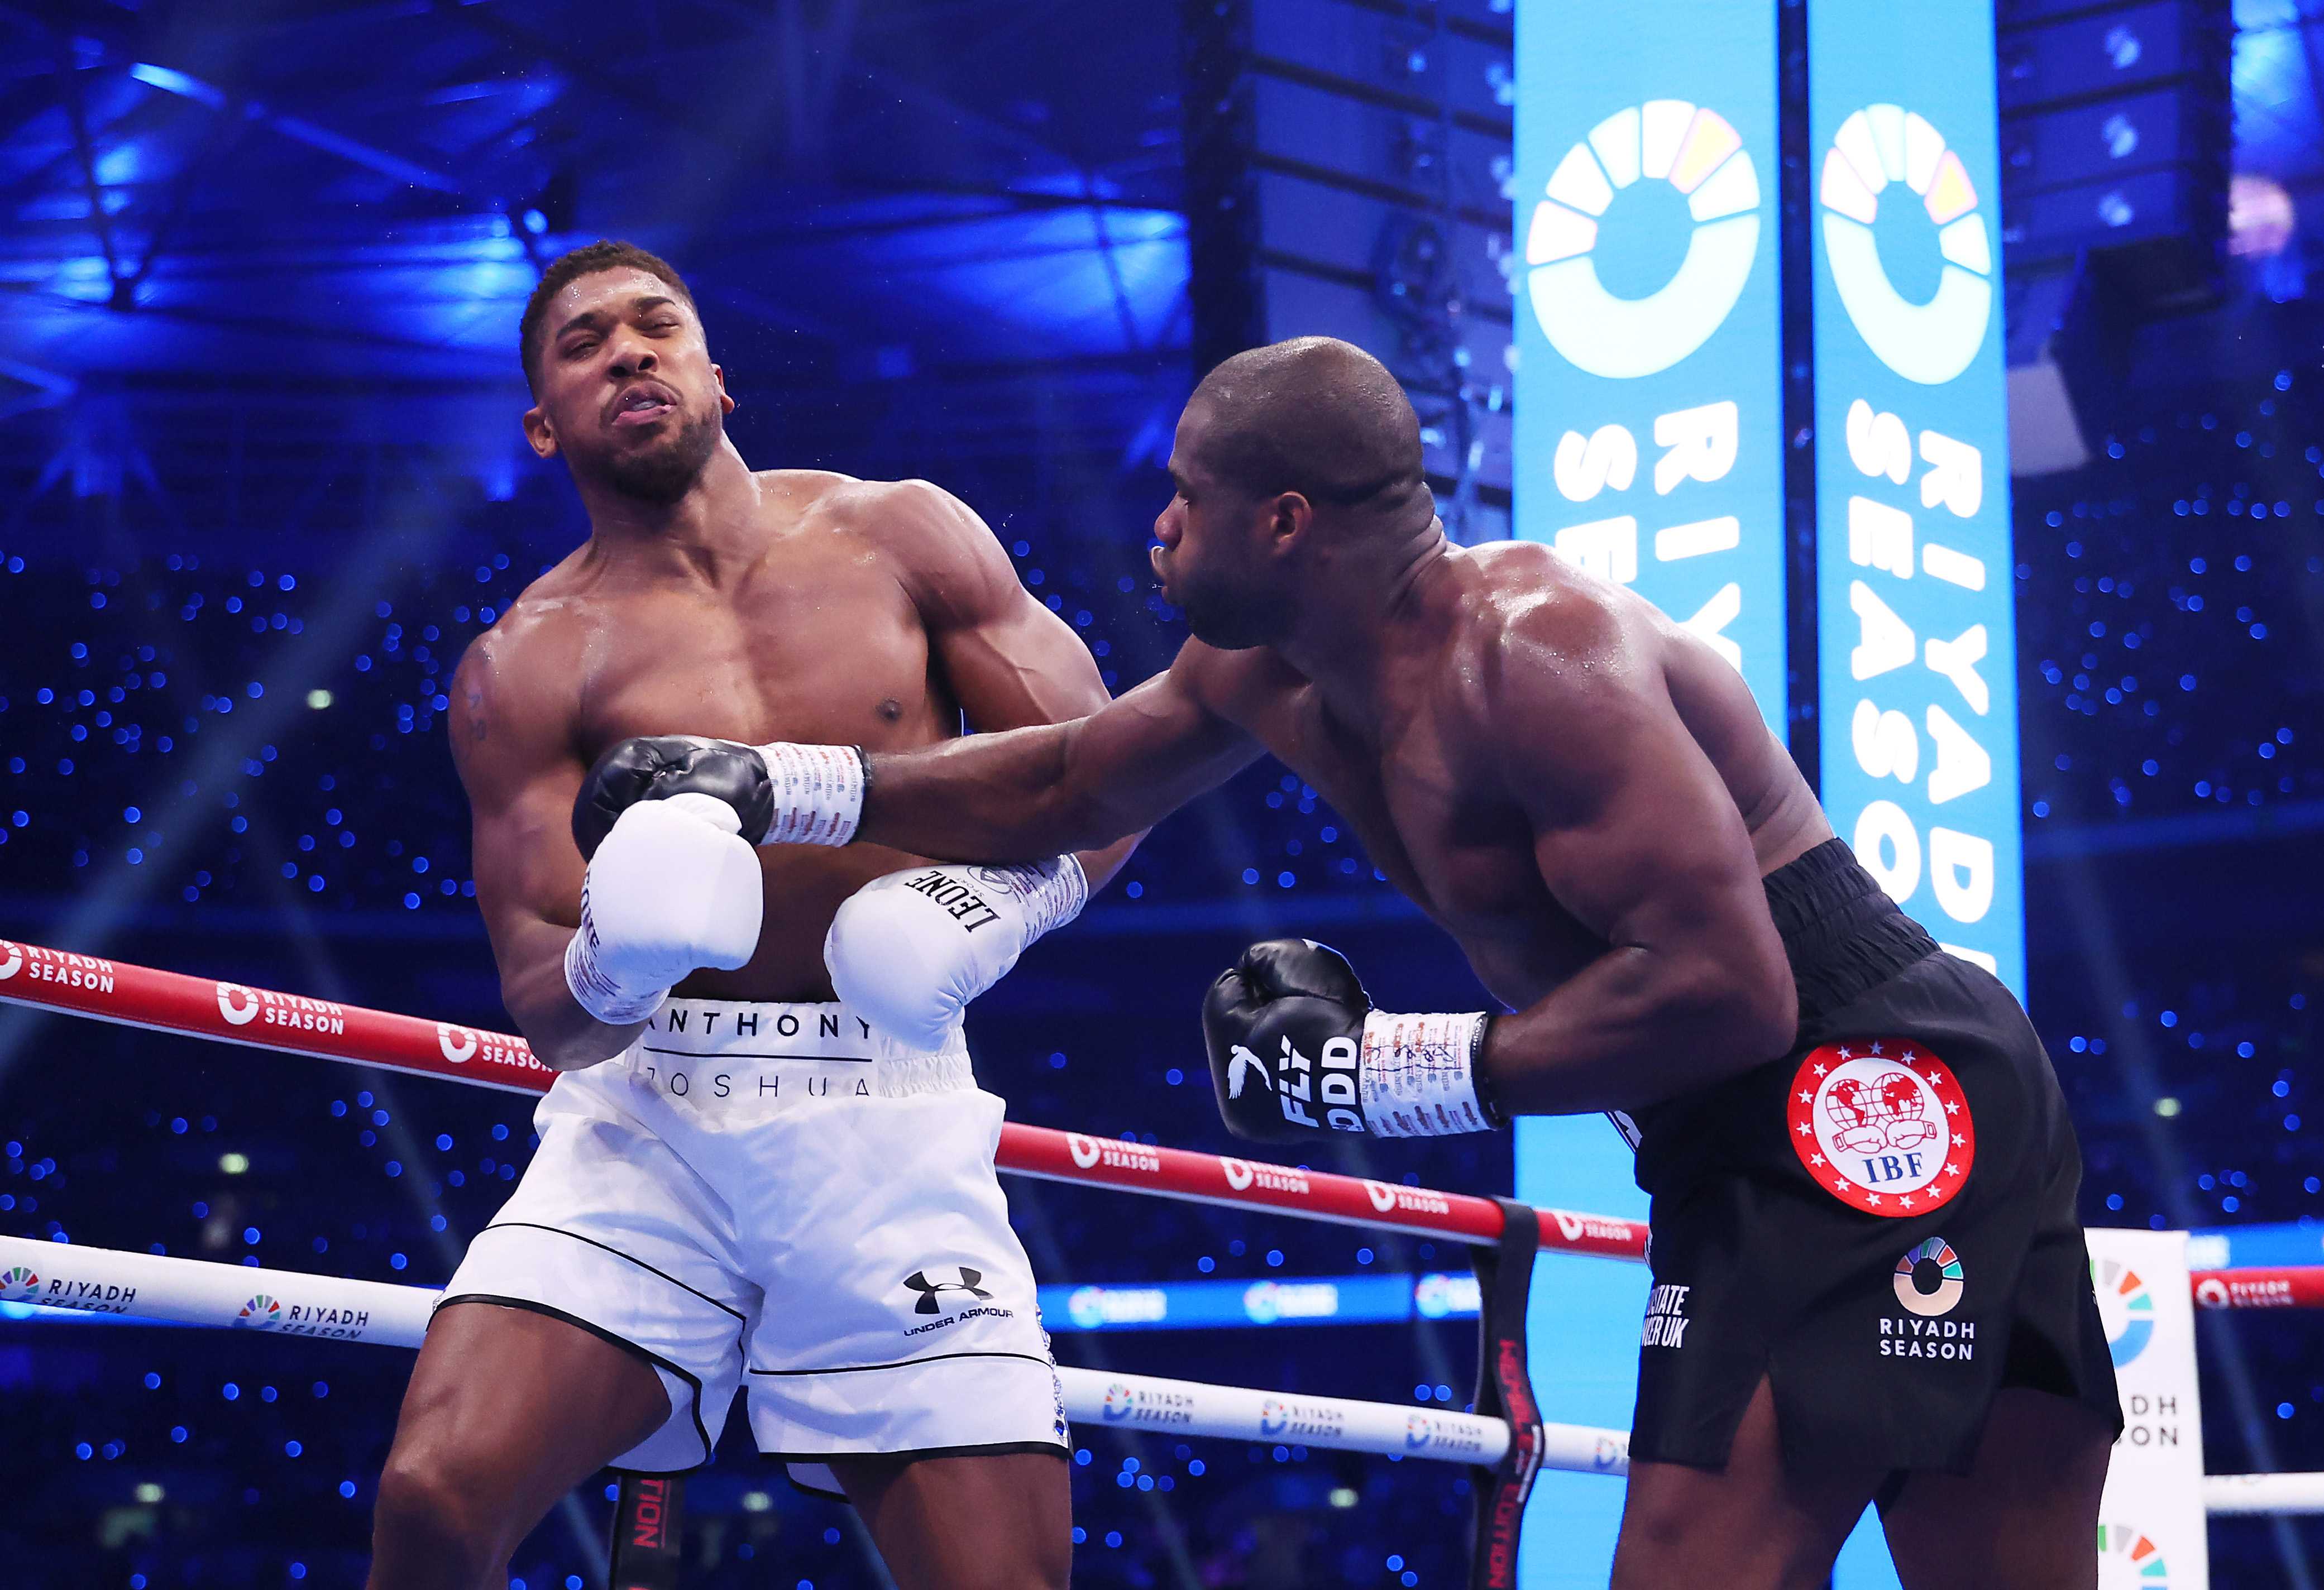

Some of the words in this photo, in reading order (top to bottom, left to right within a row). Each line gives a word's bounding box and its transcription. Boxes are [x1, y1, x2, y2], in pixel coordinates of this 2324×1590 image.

[905, 870, 1002, 933] LEONE
[26, 945, 113, 974] RIYADH
[29, 961, 114, 994] SEASON
[261, 990, 343, 1017] RIYADH
[264, 1008, 345, 1035] SEASON
[649, 1008, 870, 1040] NTHONY
[1279, 1035, 1319, 1128] FLY
[1103, 1150, 1160, 1172] SEASON
[1862, 1152, 1924, 1184] IBF
[49, 1278, 136, 1303] RIYADH
[289, 1305, 369, 1326] RIYADH
[903, 1316, 955, 1337] UNDER
[959, 1307, 1013, 1322] ARMOUR
[1880, 1318, 1975, 1339] RIYADH
[1662, 1316, 1689, 1348] UK
[1880, 1340, 1973, 1361] SEASON
[1139, 1391, 1194, 1407] RIYADH
[2116, 1426, 2177, 1446] ON
